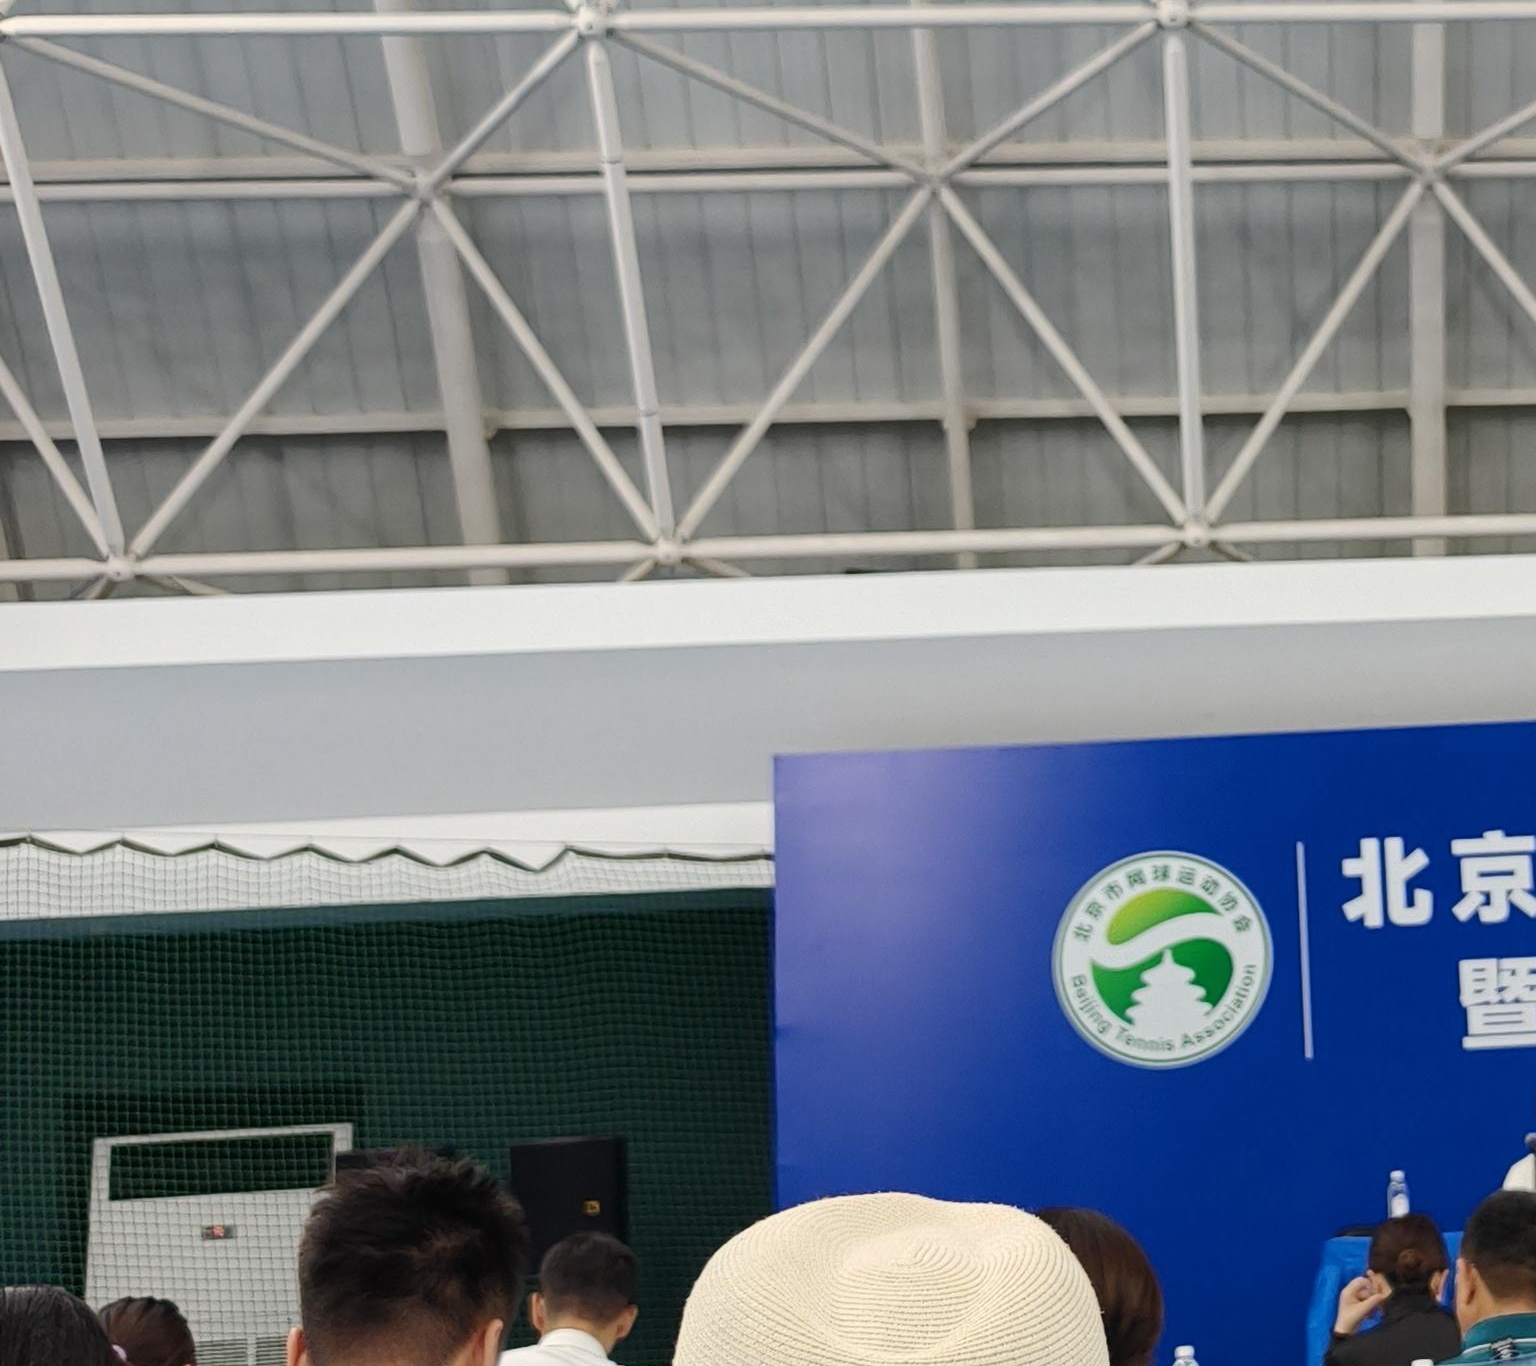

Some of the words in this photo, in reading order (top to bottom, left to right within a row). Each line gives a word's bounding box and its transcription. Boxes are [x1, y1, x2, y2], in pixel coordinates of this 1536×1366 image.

[1072, 864, 1252, 942] 北京市网球运动协会
[1072, 973, 1113, 1034] Beijing
[1117, 1025, 1177, 1052] Tennis
[1181, 963, 1257, 1049] Association
